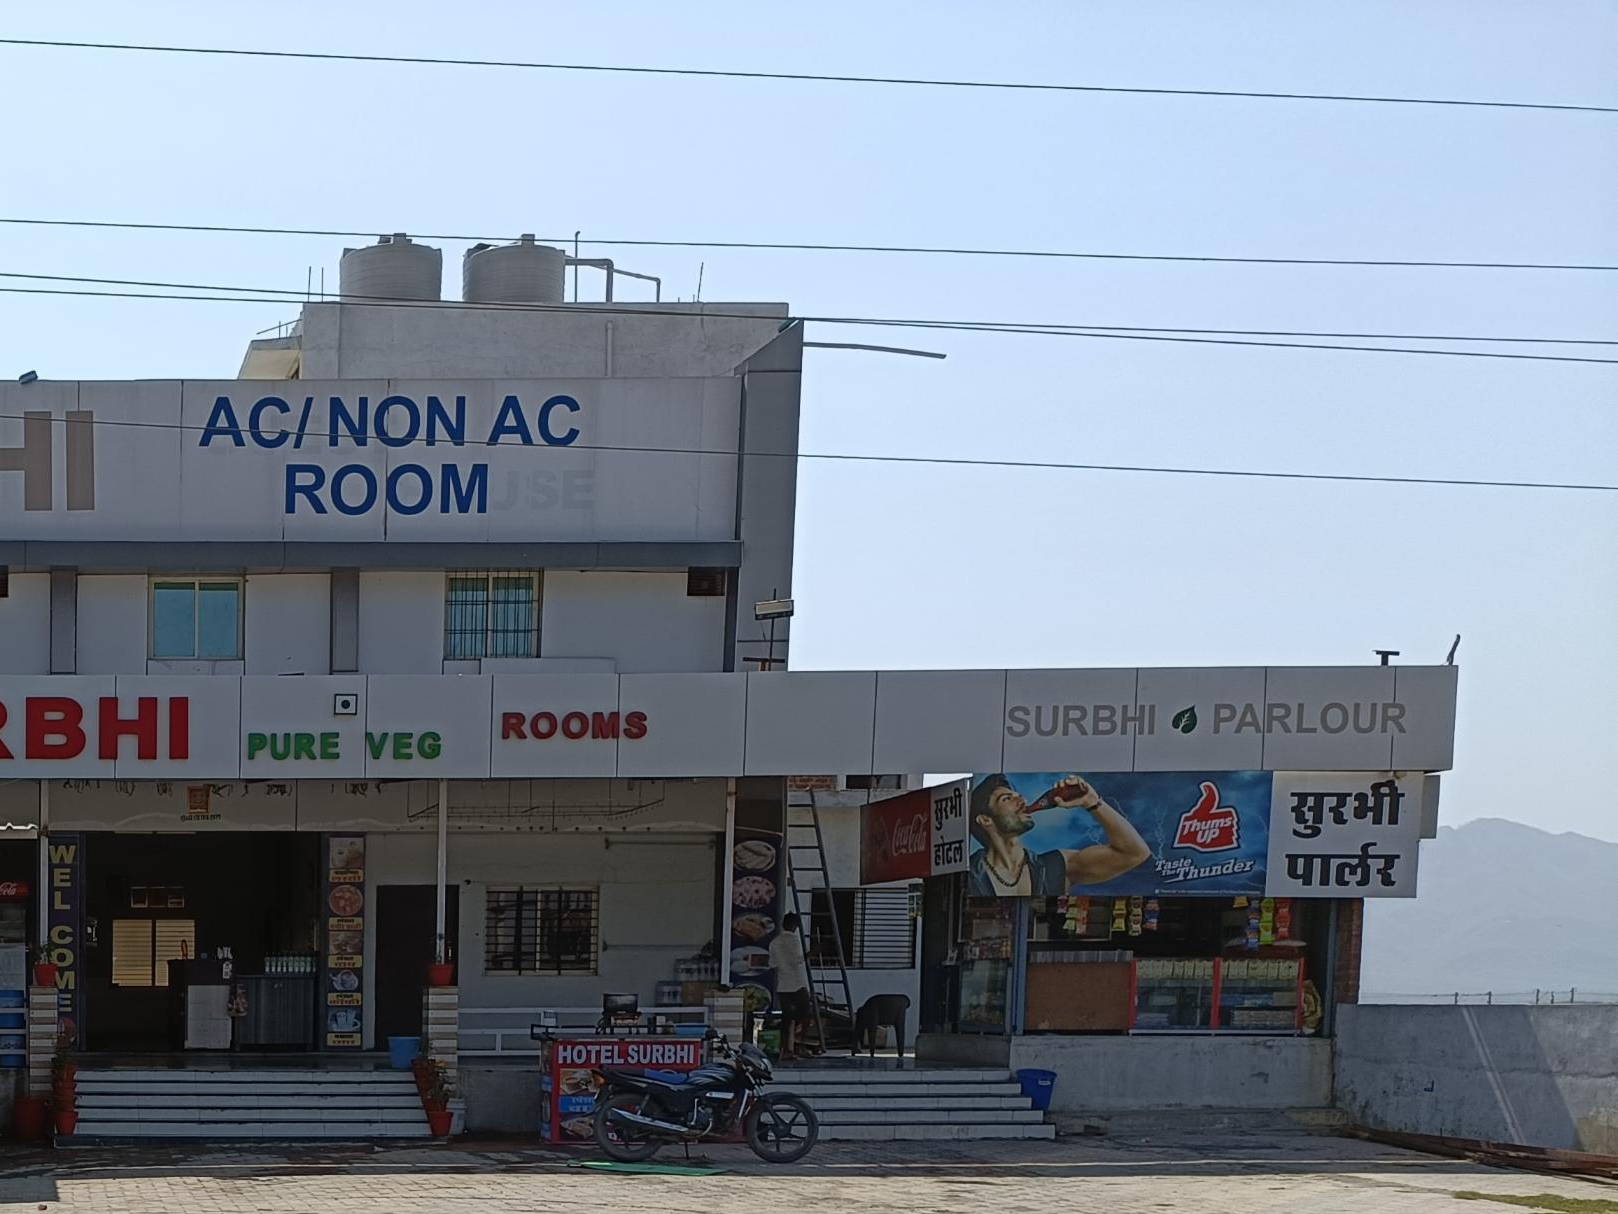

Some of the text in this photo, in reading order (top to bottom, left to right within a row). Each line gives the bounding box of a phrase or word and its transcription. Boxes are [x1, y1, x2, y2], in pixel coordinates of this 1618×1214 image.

[486, 395, 581, 447] AC
[285, 463, 489, 514] ROOM
[501, 711, 648, 740] ROOMS
[1005, 702, 1407, 737] SURBHI PARLOUR
[248, 731, 442, 760] PURE VEG
[934, 787, 963, 831] सुरभी
[1290, 780, 1406, 839] सुरभी
[1183, 816, 1233, 836] Thums
[934, 836, 964, 866] होटल
[1154, 857, 1193, 872] Taste
[1285, 842, 1401, 887] पार्लर
[1161, 859, 1255, 884] The Thunder
[557, 1044, 695, 1065] HOTEL SURBHI
